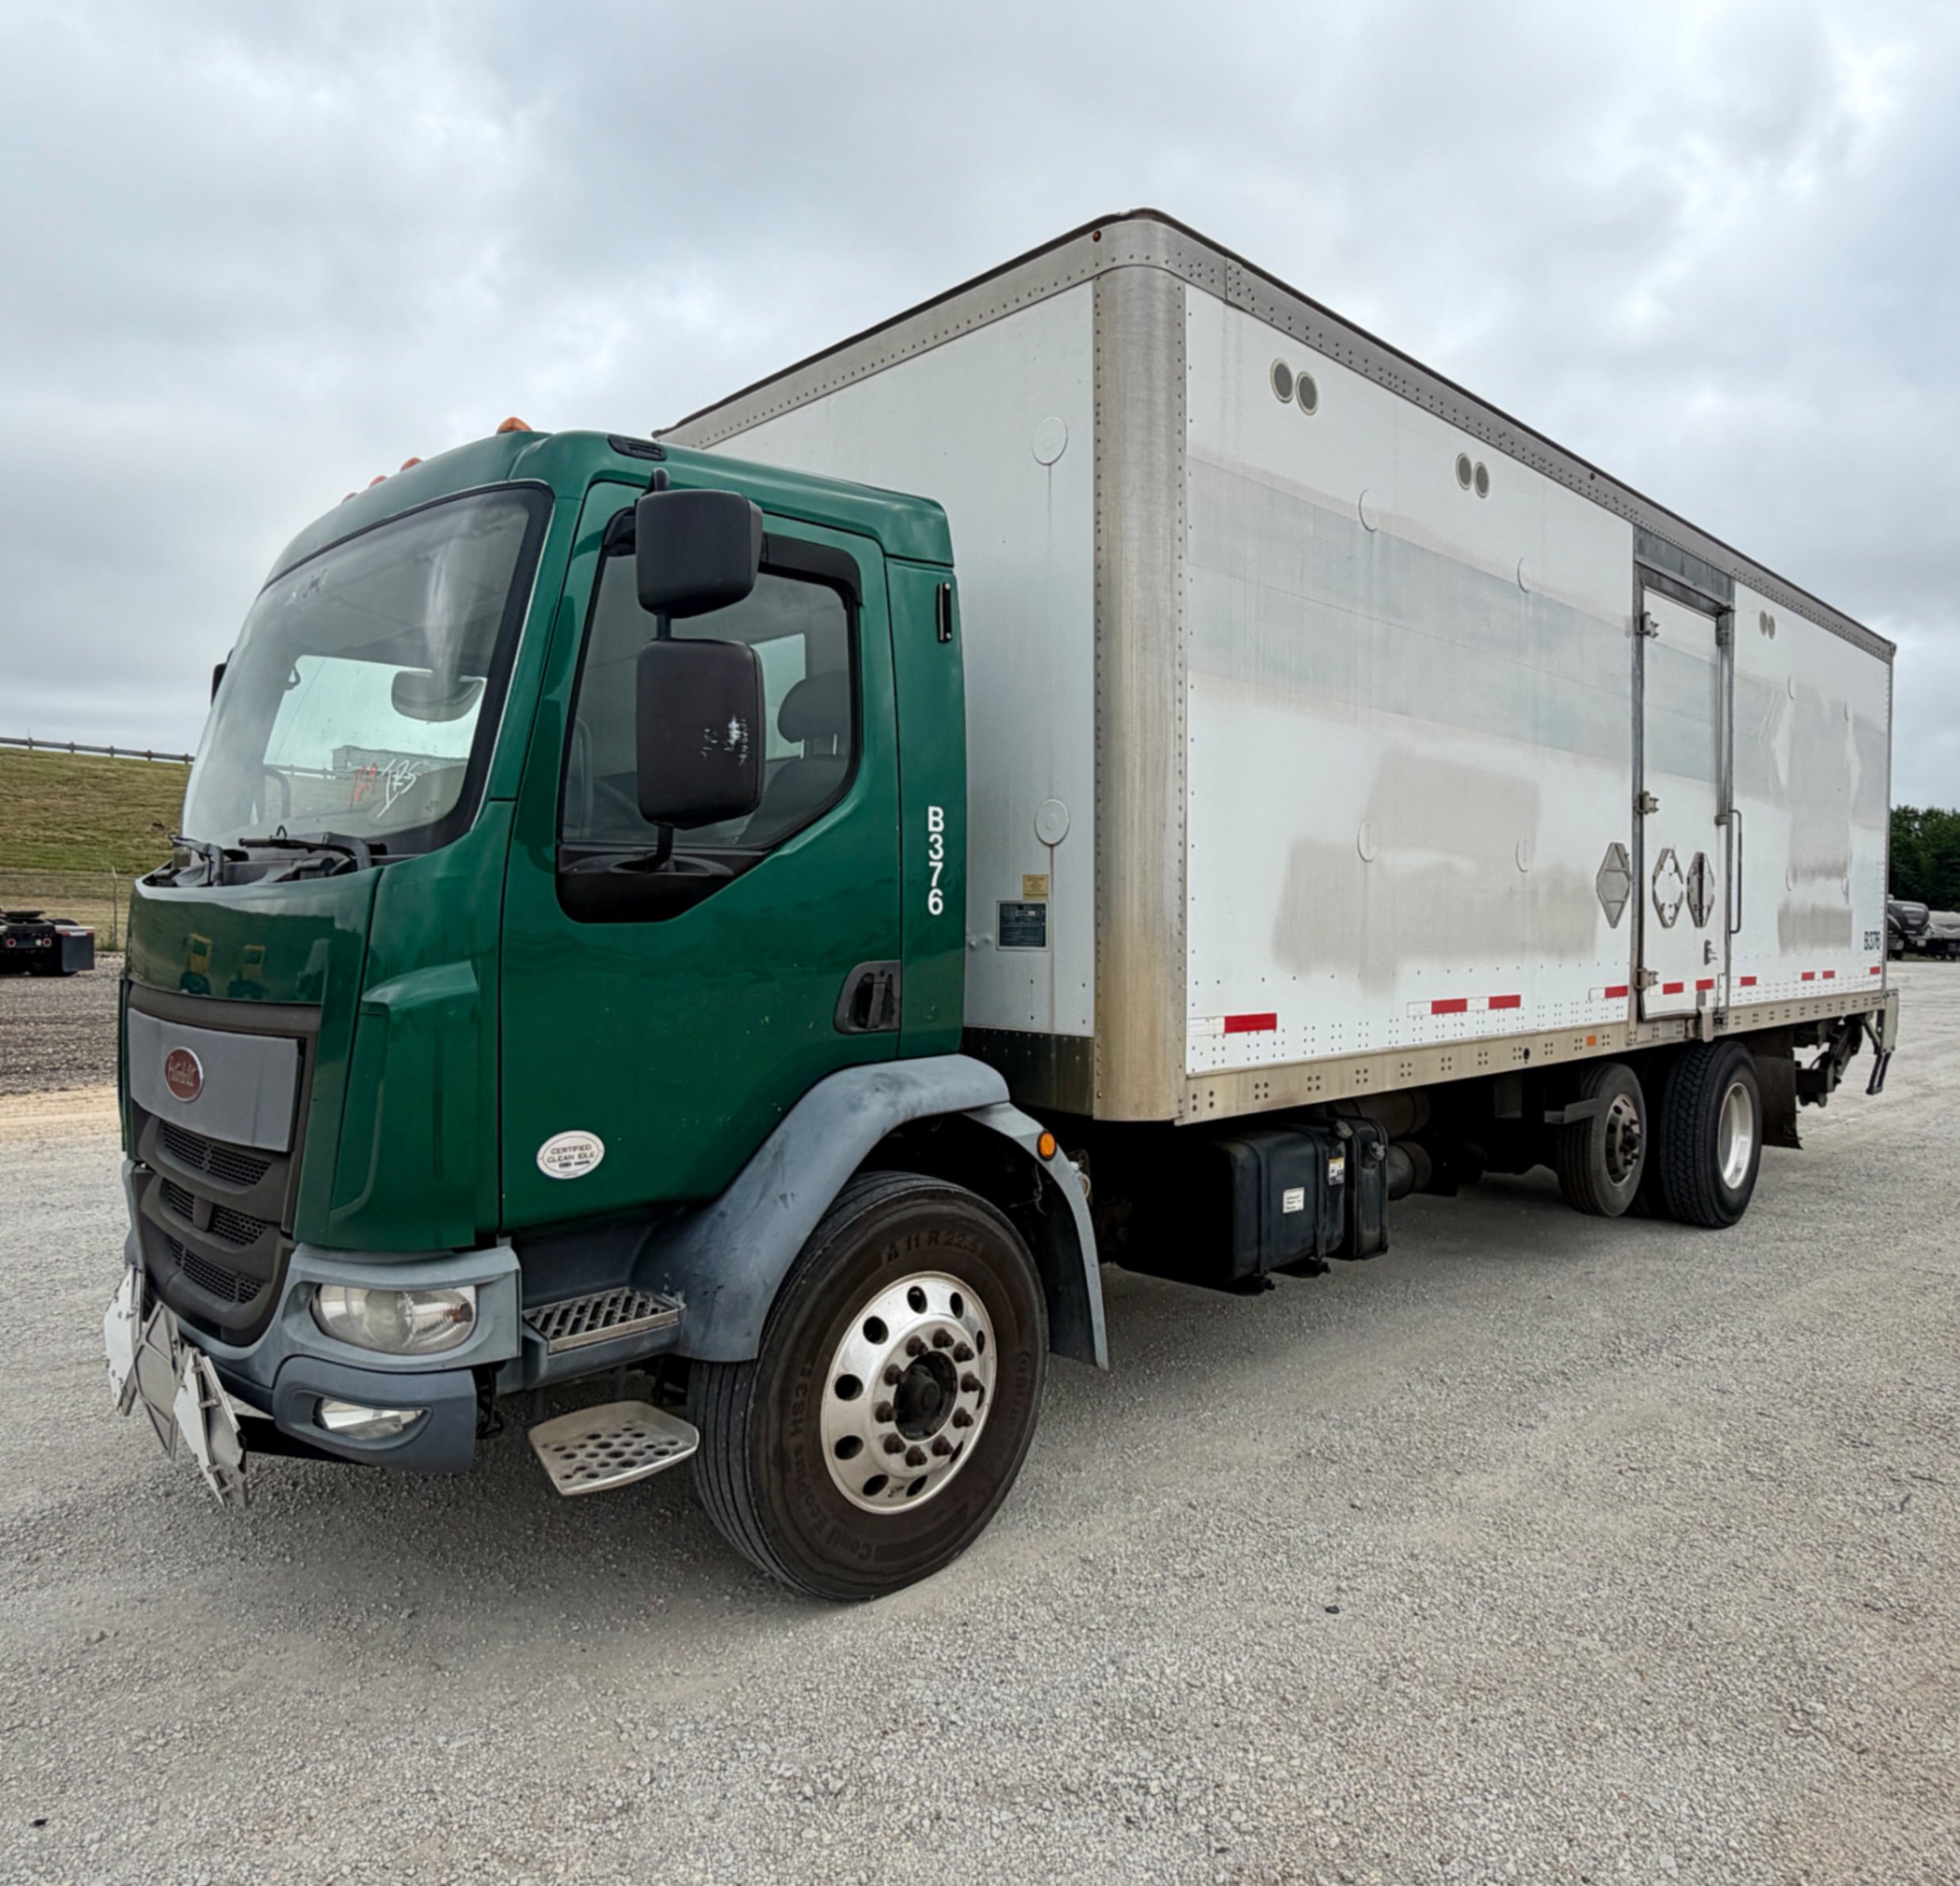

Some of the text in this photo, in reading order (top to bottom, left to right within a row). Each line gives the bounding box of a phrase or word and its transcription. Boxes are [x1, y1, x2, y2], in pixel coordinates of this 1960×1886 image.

[928, 806, 944, 915] B376
[551, 1143, 592, 1155] CERTIFIED
[547, 1154, 574, 1163] CLEAN
